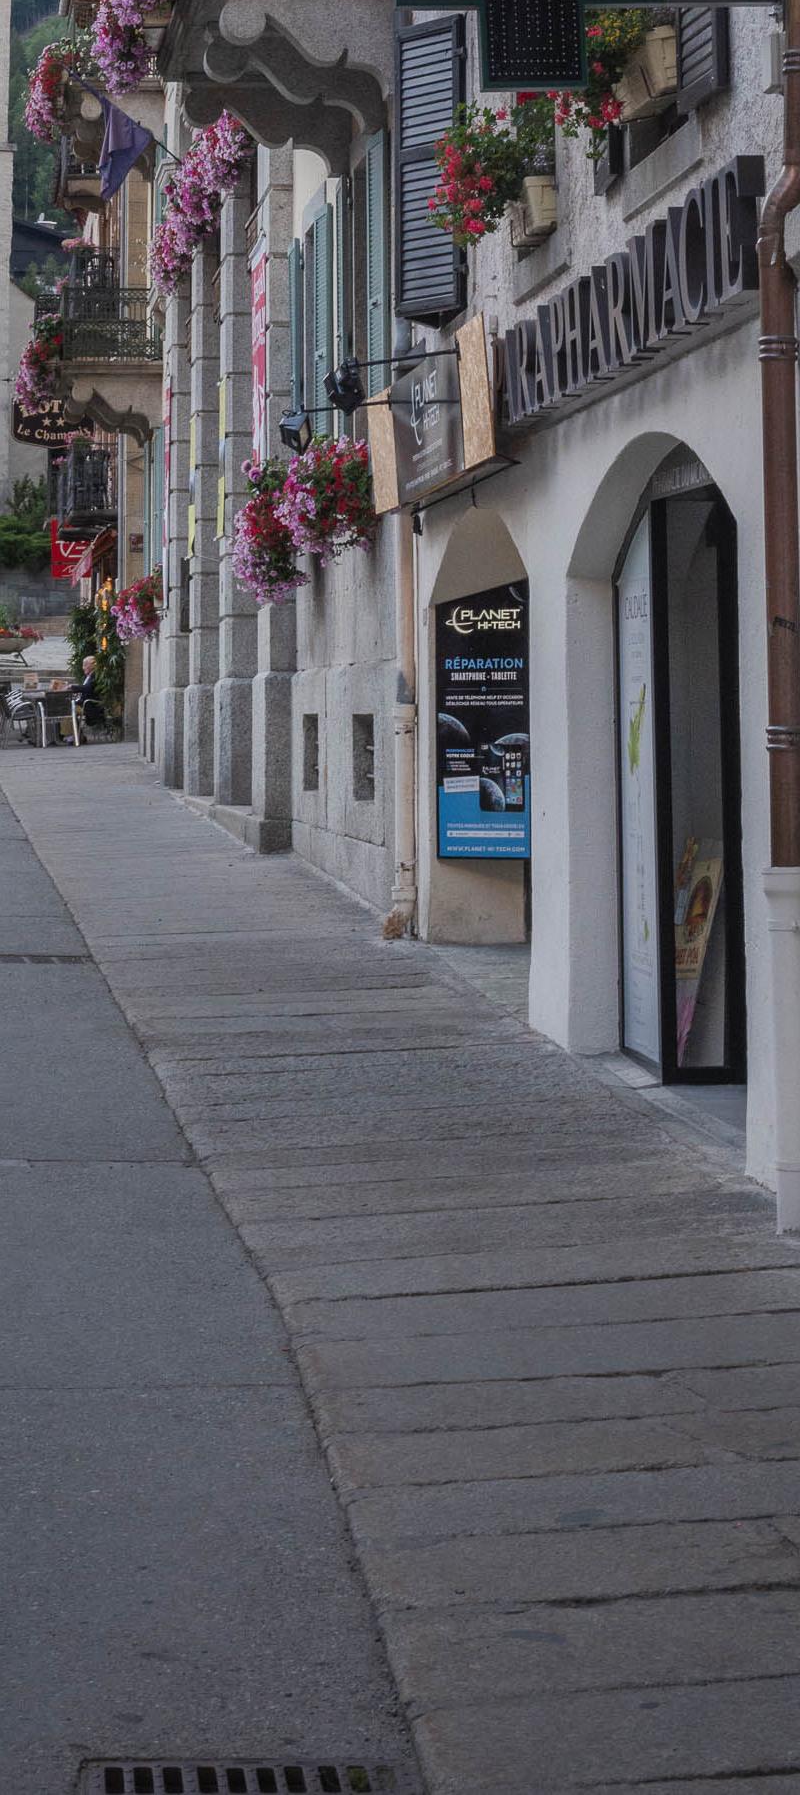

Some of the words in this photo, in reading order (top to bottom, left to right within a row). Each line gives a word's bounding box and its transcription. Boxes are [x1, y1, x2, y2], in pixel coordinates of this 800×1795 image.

[415, 369, 437, 410] PLANET
[19, 399, 62, 418] HOT
[17, 424, 31, 436] Le
[461, 609, 520, 620] PLANET
[477, 621, 520, 630] HI-TECH
[445, 656, 523, 670] RÉPARATION
[451, 672, 486, 681] SMARTPHONE
[491, 671, 517, 680] TABLETTE
